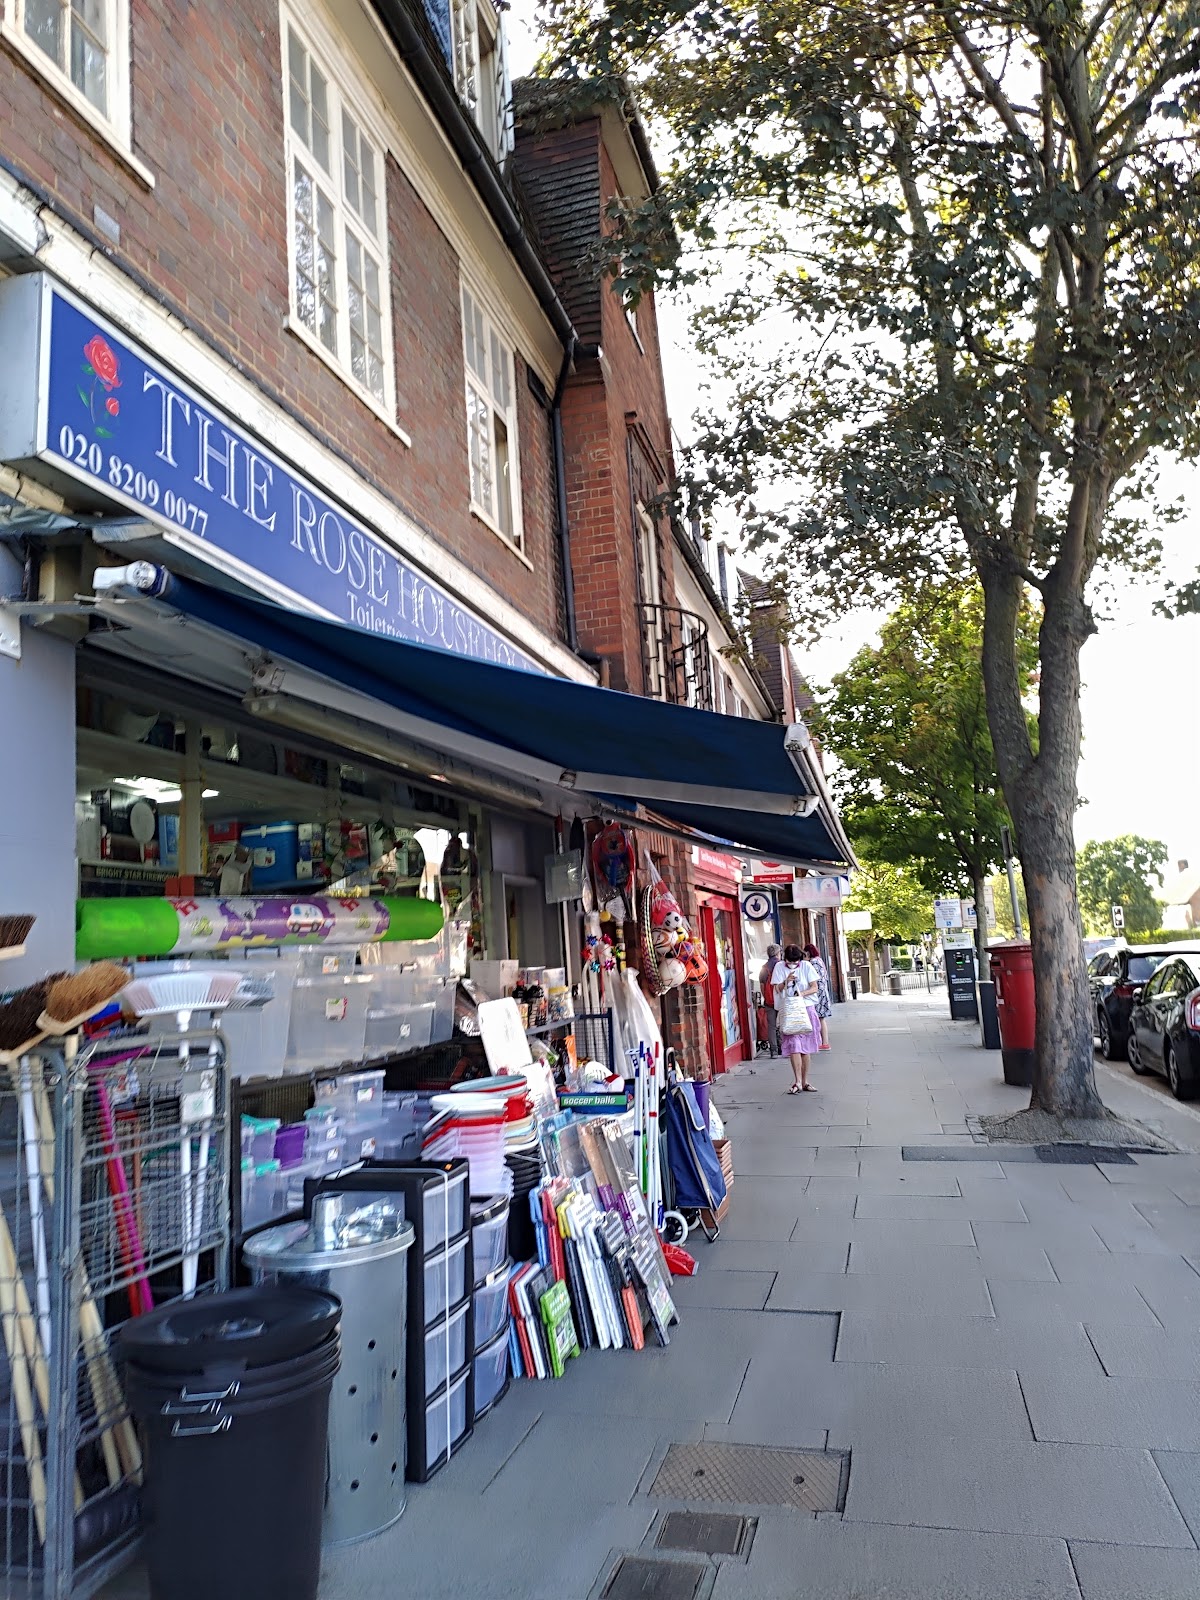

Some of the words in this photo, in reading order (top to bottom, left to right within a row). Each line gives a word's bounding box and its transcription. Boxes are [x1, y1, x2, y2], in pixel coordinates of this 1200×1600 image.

[59, 424, 103, 475] 020
[108, 455, 160, 507] 8209
[164, 489, 208, 537] 0077
[143, 370, 277, 532] THE
[290, 482, 389, 606] ROSE
[96, 865, 122, 879] BRIGHT
[564, 1096, 593, 1105] soccer
[595, 1095, 616, 1105] balls
